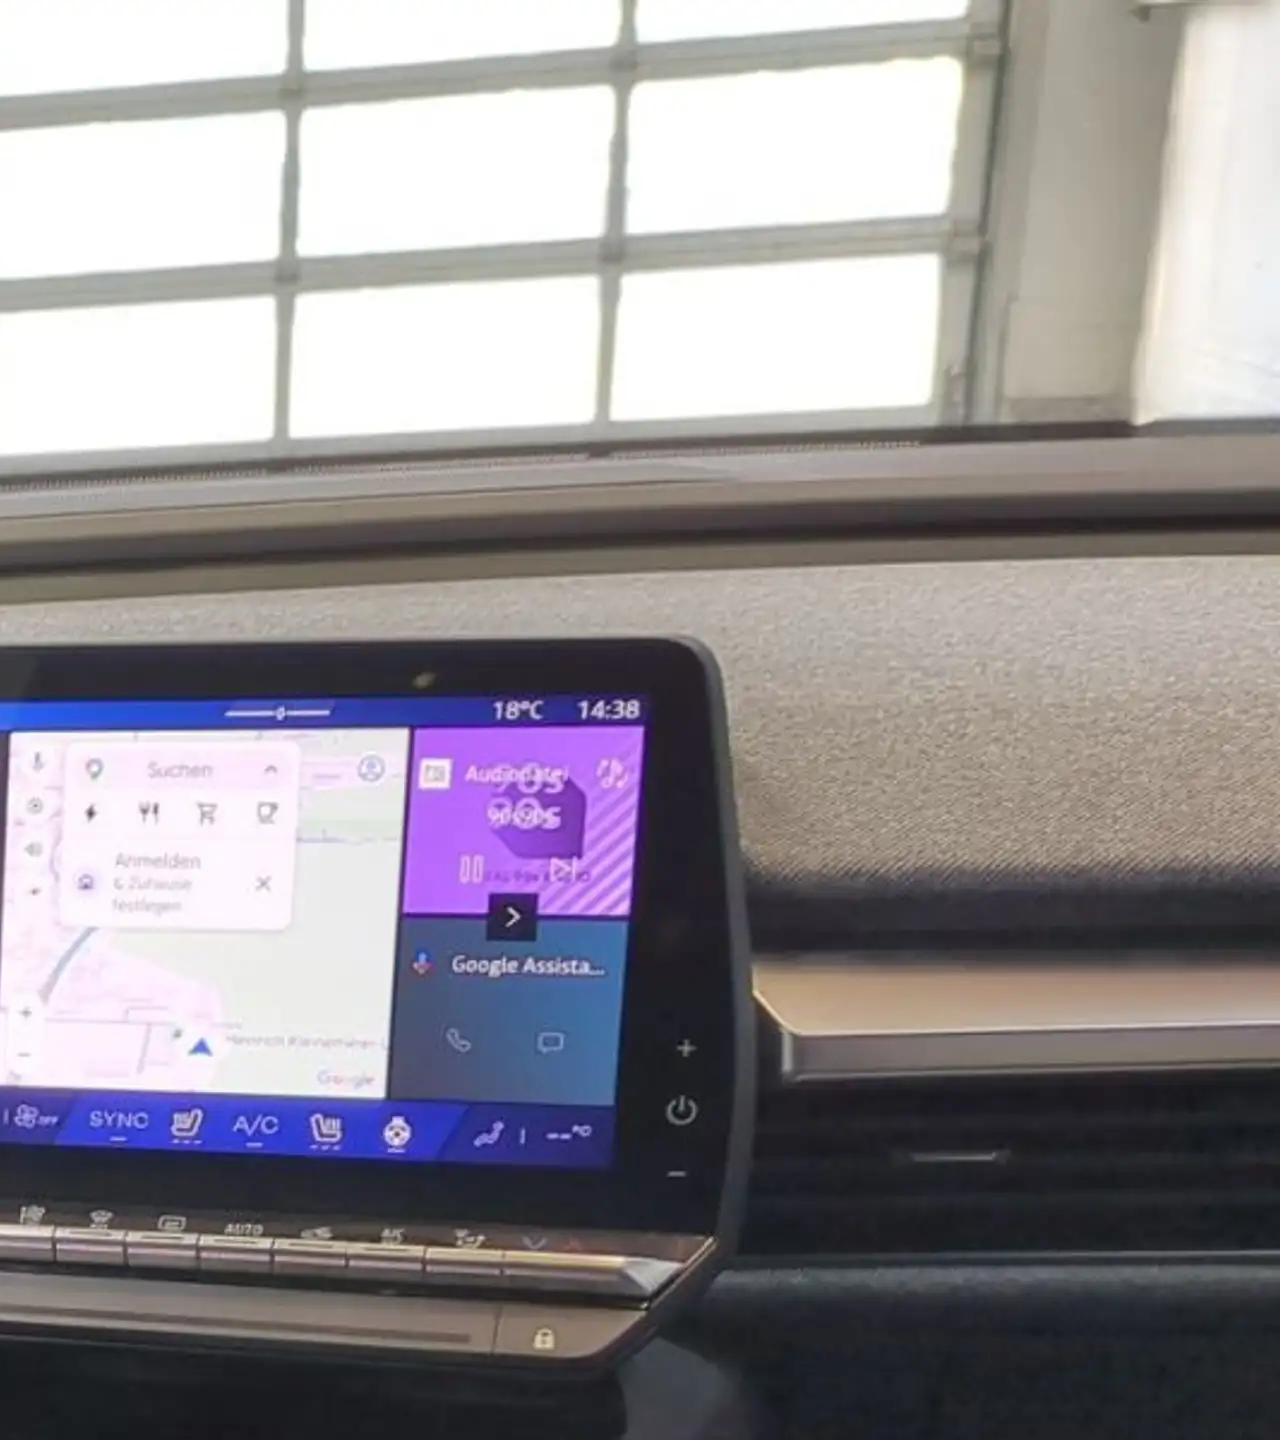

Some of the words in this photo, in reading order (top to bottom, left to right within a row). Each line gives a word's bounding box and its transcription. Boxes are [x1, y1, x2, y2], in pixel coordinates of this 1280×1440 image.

[577, 699, 641, 720] 14:38
[147, 760, 214, 780] Suchen
[114, 852, 202, 871] Anmelden
[130, 875, 193, 891] Zuhause
[111, 896, 183, 915] festlegen
[451, 955, 519, 978] Google
[89, 1110, 149, 1130] SYNC
[233, 1113, 279, 1135] A/C
[223, 1222, 265, 1237] AUTO
